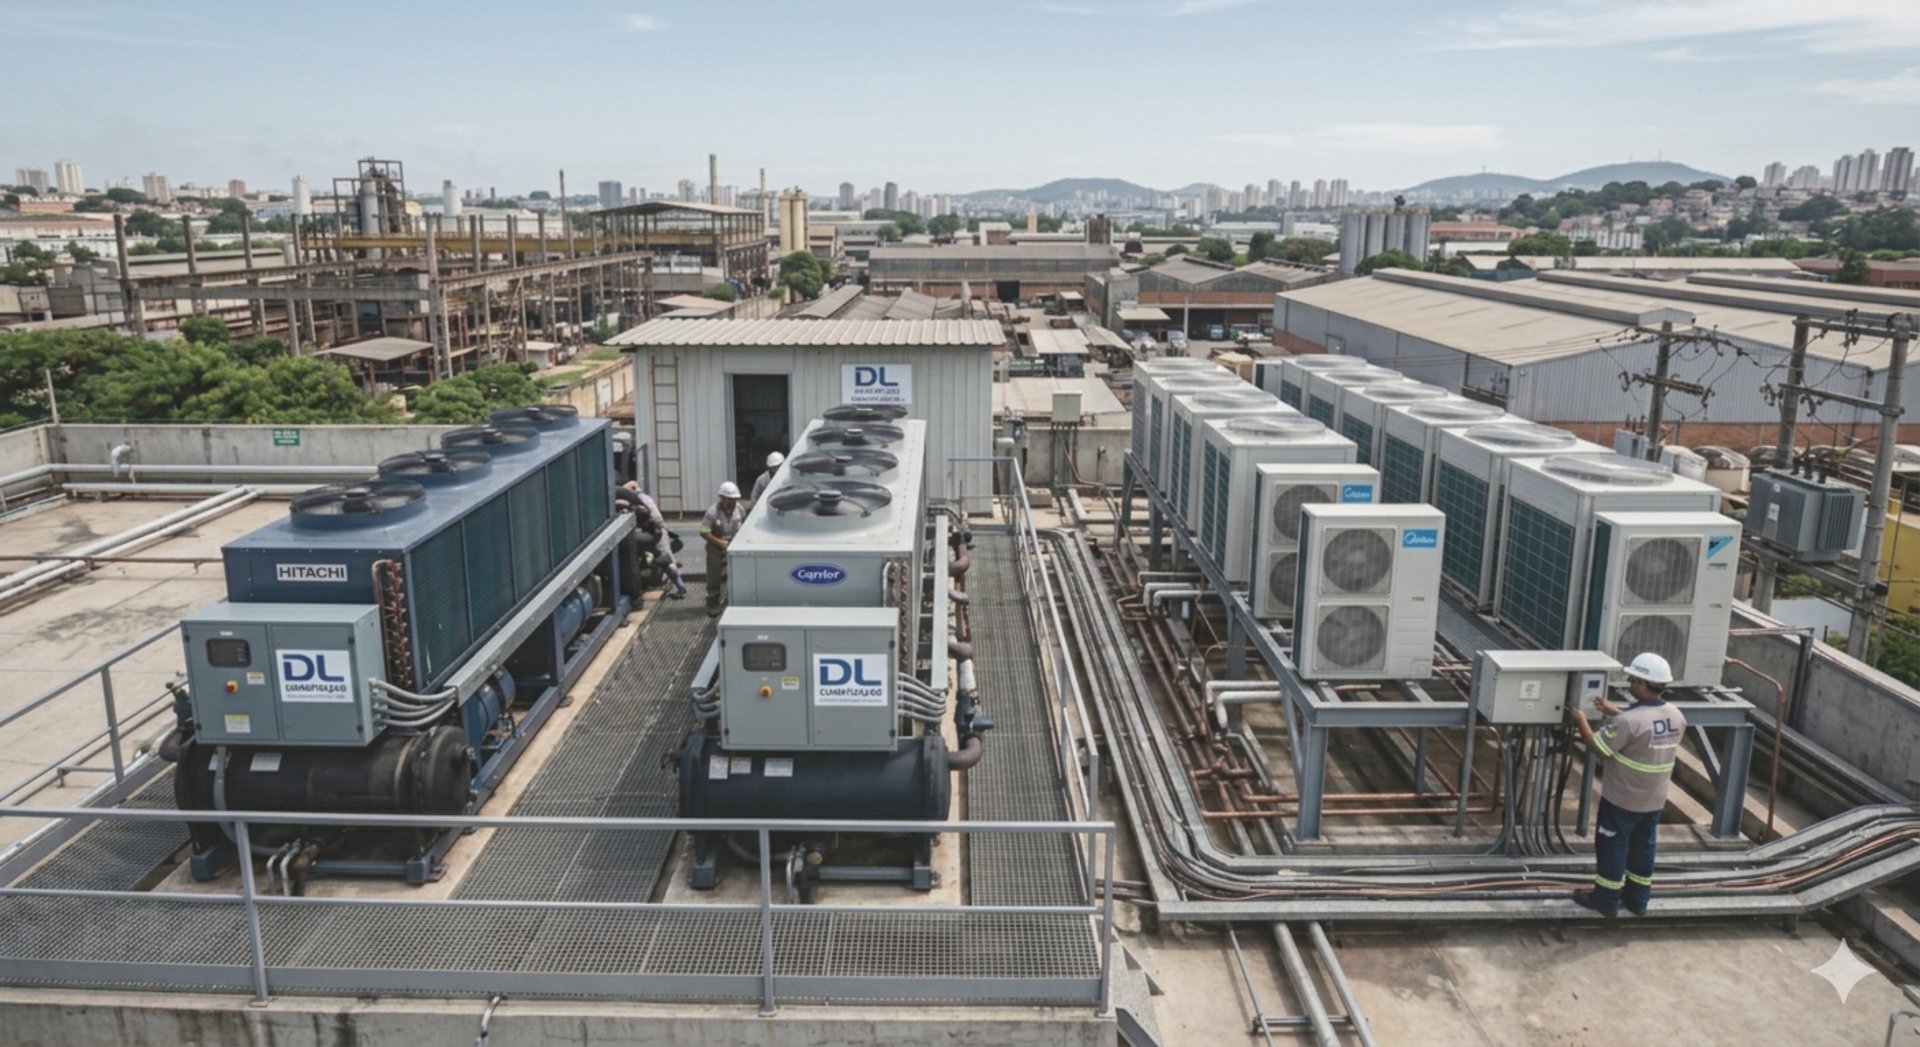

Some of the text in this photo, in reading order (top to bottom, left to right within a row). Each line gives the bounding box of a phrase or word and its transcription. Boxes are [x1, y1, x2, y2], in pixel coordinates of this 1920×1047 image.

[855, 366, 899, 387] DL
[279, 566, 345, 579] HITACHI
[282, 653, 345, 682] DL
[819, 658, 882, 686] DL
[1652, 718, 1680, 735] DL
